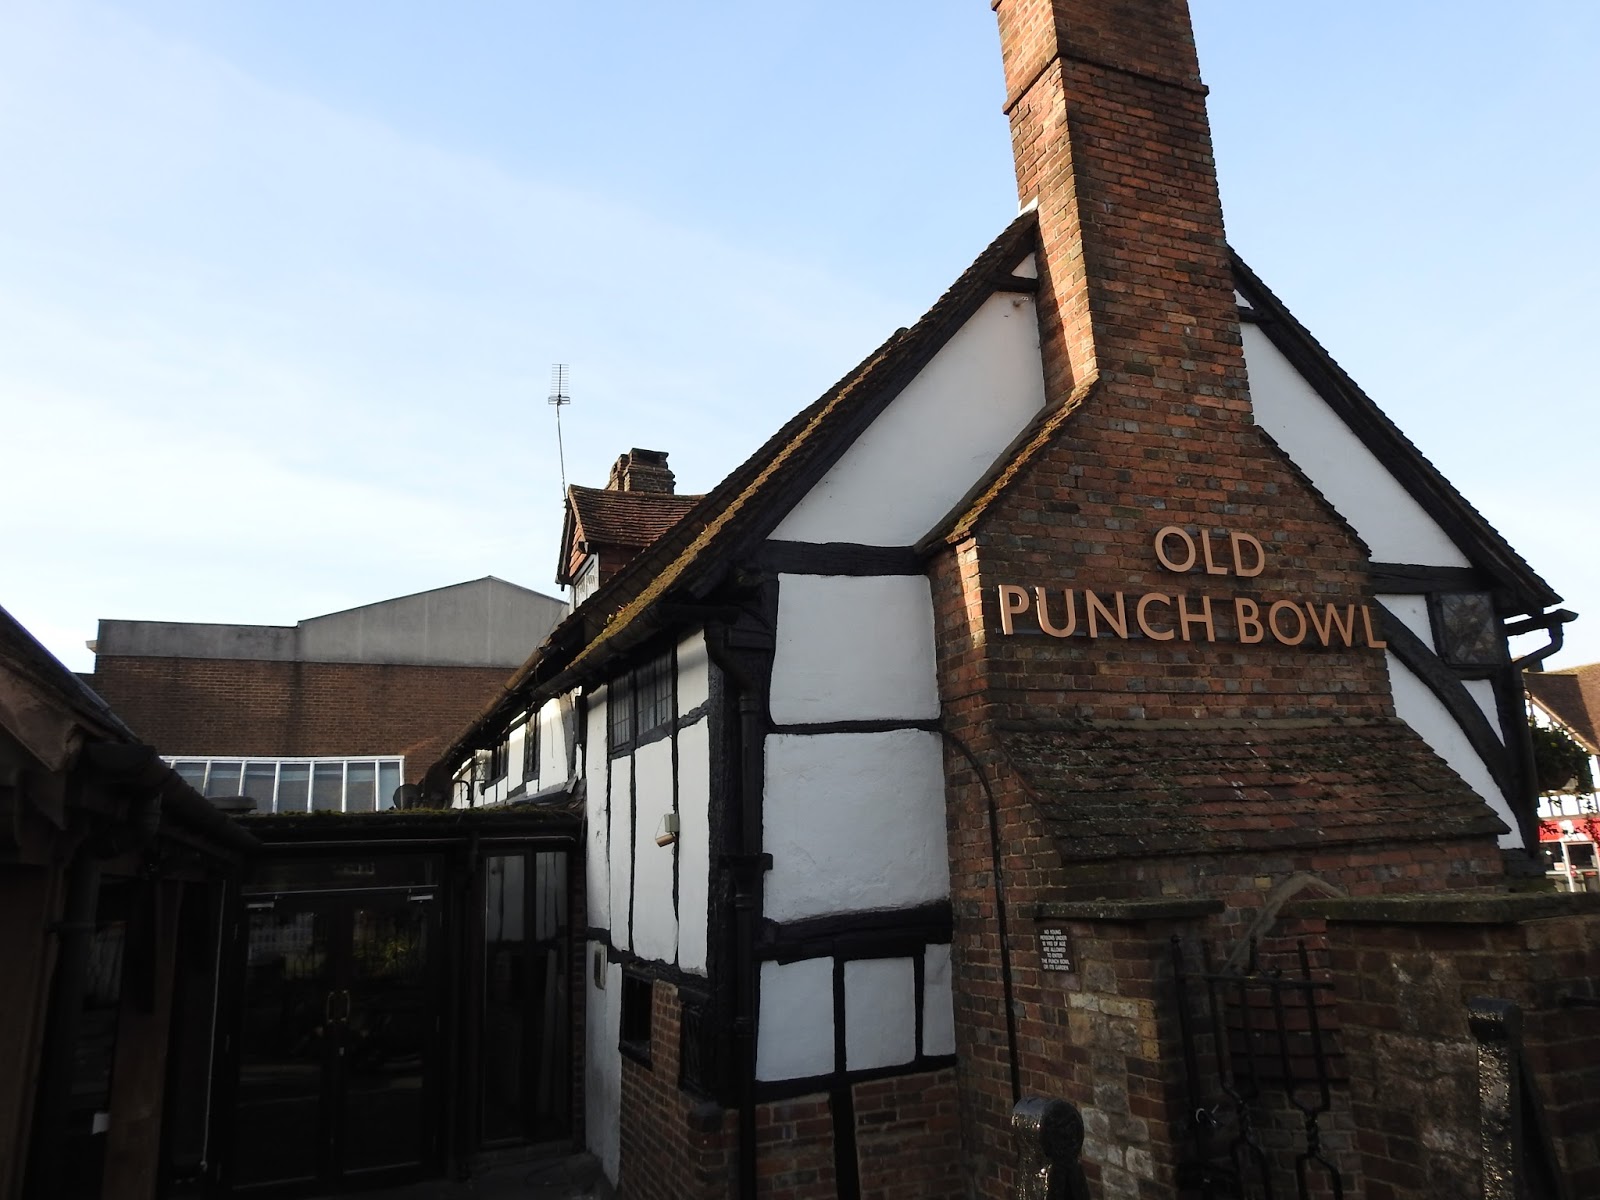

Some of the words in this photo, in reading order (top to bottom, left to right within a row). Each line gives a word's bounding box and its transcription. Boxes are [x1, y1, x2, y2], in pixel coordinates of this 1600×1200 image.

[1154, 526, 1266, 578] OLD
[998, 584, 1217, 642] PUNCH
[1234, 597, 1387, 649] BOWL
